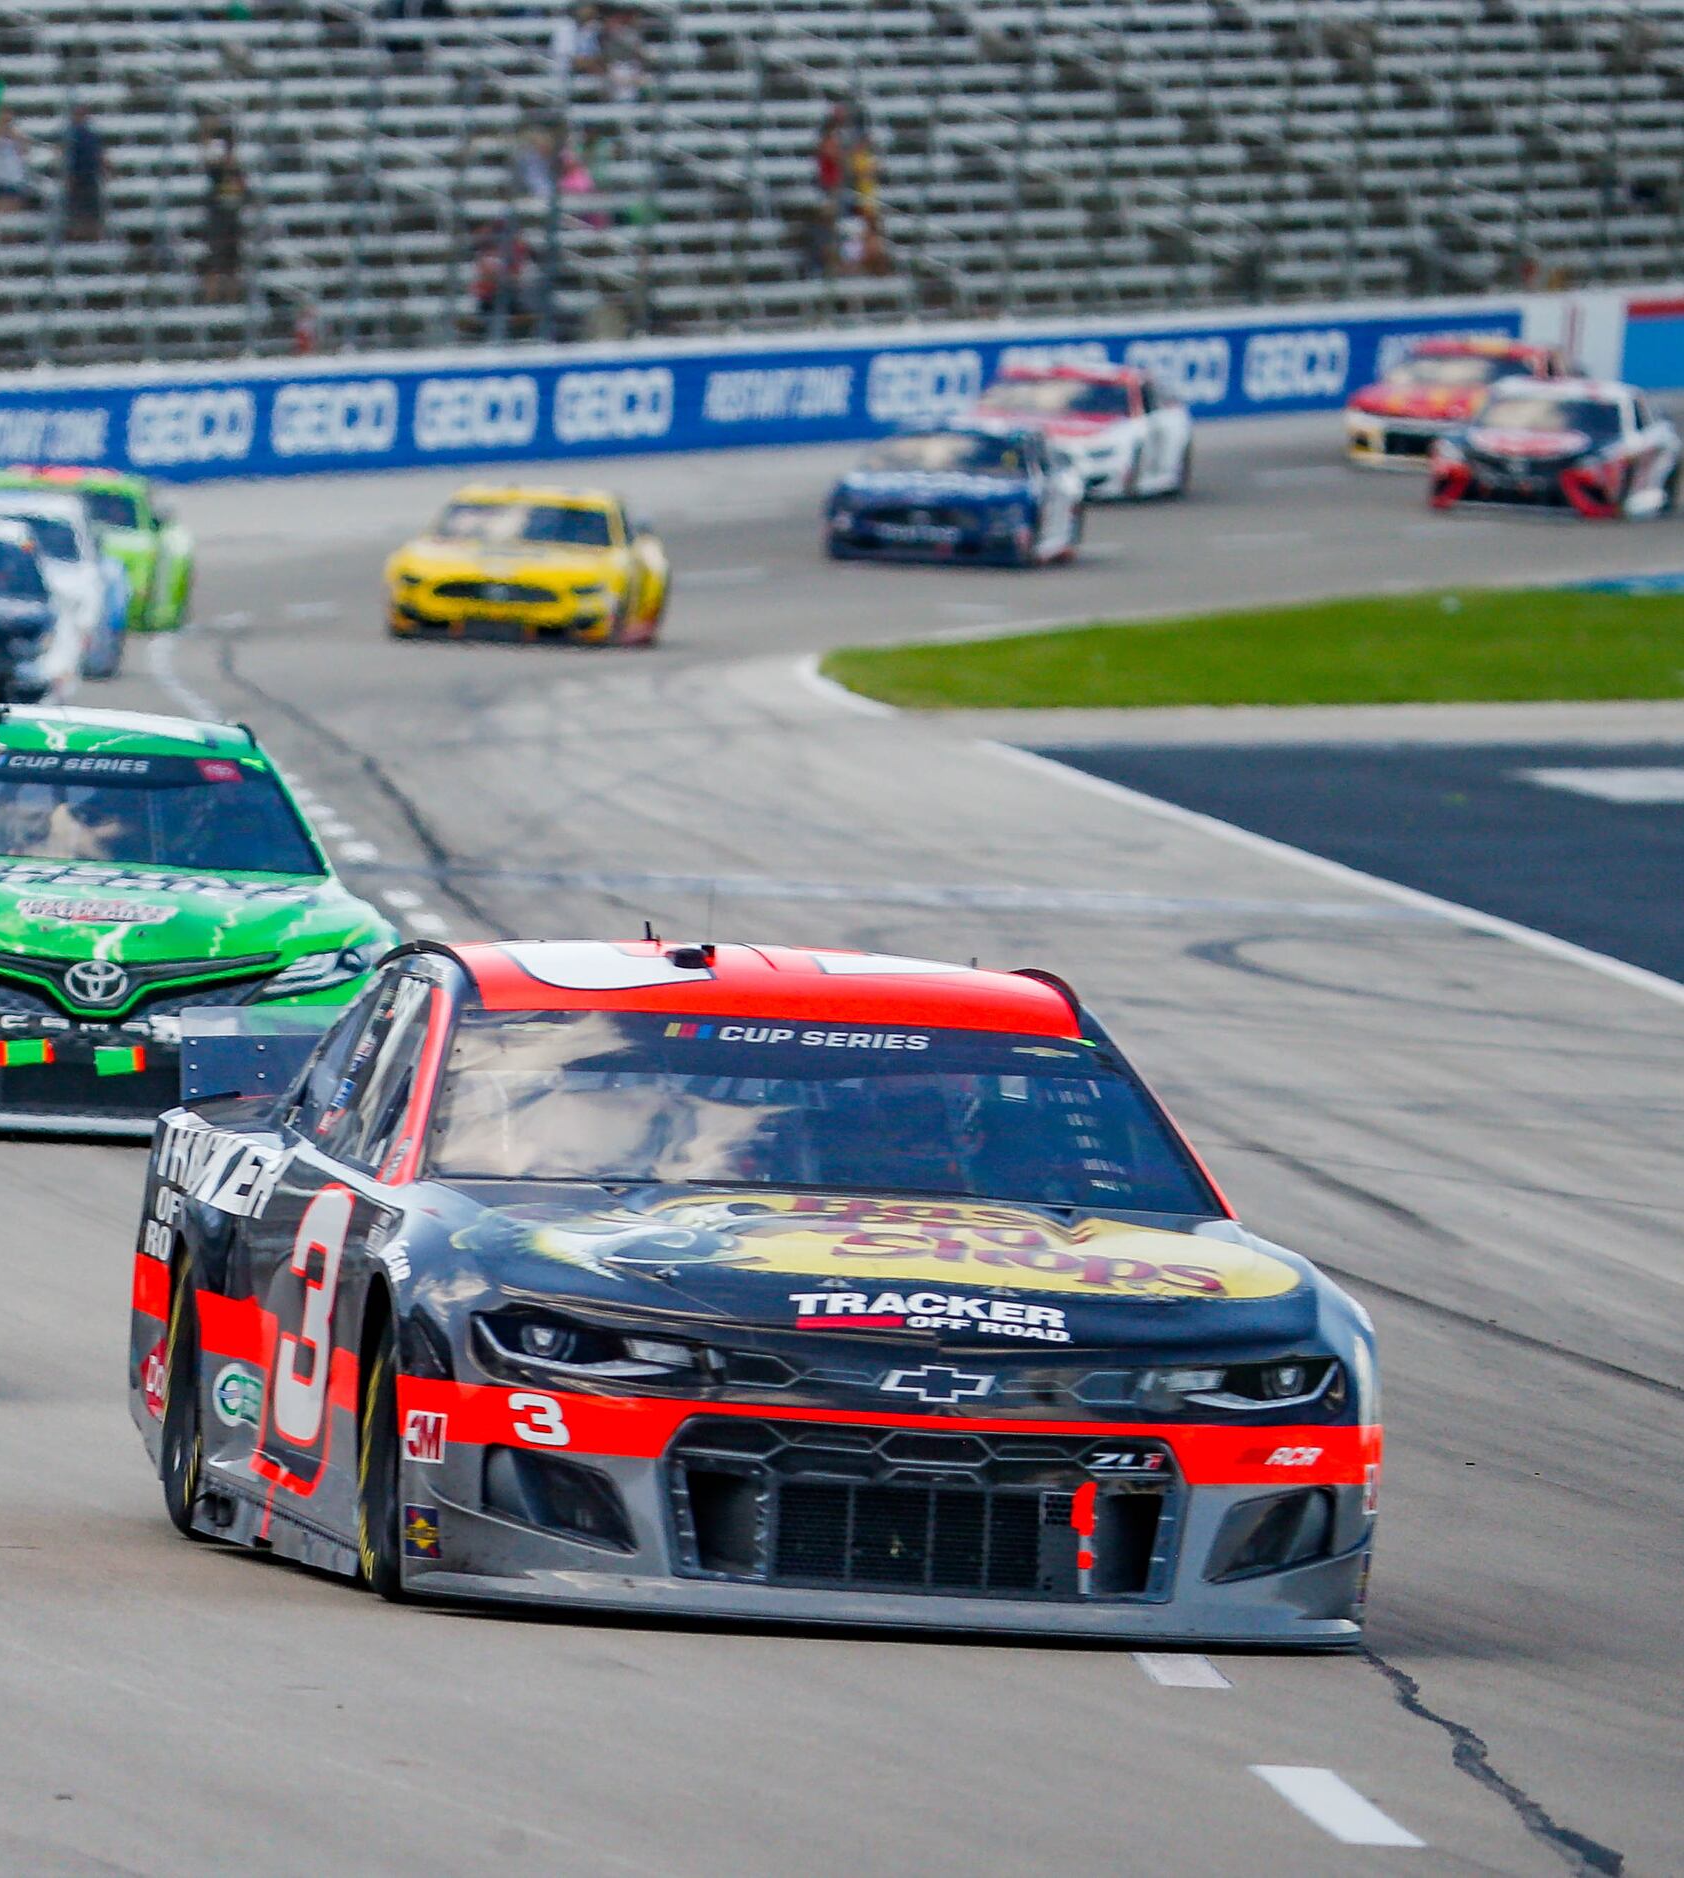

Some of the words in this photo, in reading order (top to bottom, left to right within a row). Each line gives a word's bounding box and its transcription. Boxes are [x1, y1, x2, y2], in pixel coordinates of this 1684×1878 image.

[867, 351, 982, 424] GEICO
[1239, 329, 1350, 398] GEICO
[126, 390, 256, 465] GEICO
[271, 381, 398, 457] GEICO
[415, 375, 539, 451] GEICO
[554, 367, 674, 442] GEICO
[7, 755, 60, 770] CUP
[62, 758, 151, 775] SERIES
[718, 1025, 794, 1044] CUP
[800, 1030, 930, 1050] SERIES
[155, 1185, 187, 1225] OF
[833, 1231, 1227, 1297] Shops
[273, 1184, 355, 1447] 3
[789, 1292, 1067, 1329] TRACKER
[906, 1315, 971, 1331] OFF
[977, 1321, 1072, 1343] ROAD
[406, 1414, 443, 1460] 3M
[507, 1392, 571, 1447] 3
[1087, 1453, 1166, 1470] ZL1
